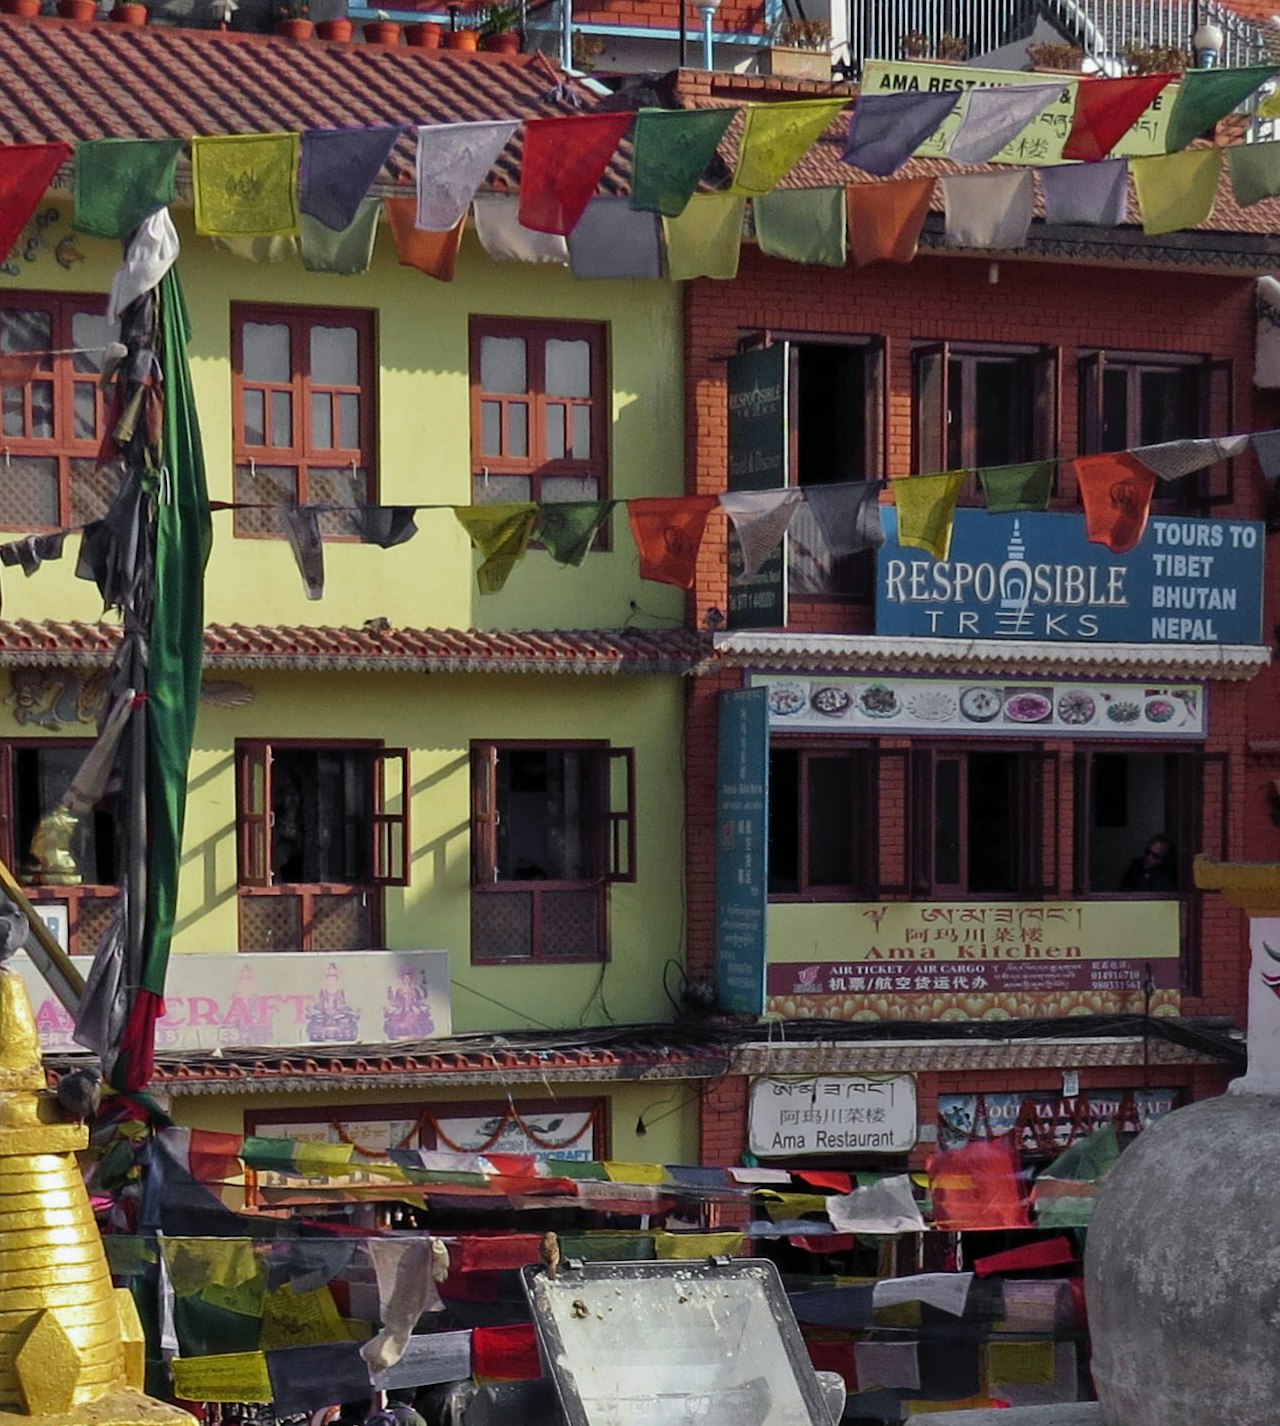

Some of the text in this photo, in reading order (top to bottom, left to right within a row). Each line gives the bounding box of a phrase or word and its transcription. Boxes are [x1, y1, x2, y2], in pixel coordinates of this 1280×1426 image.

[879, 74, 920, 92] AMA
[1153, 521, 1257, 548] TOURS TO
[1153, 554, 1214, 578] TIBET
[1151, 586, 1237, 611] BHUTAN
[1151, 617, 1218, 641] NEPAL
[864, 944, 1082, 960] Ama Kitchen
[830, 966, 854, 976] AIR
[856, 966, 904, 976] TICKET
[914, 965, 938, 975] AIR
[940, 964, 985, 974] CARGO
[780, 1107, 886, 1126] 阿玛川菜楼
[771, 1129, 895, 1150] Ama Restaurant
